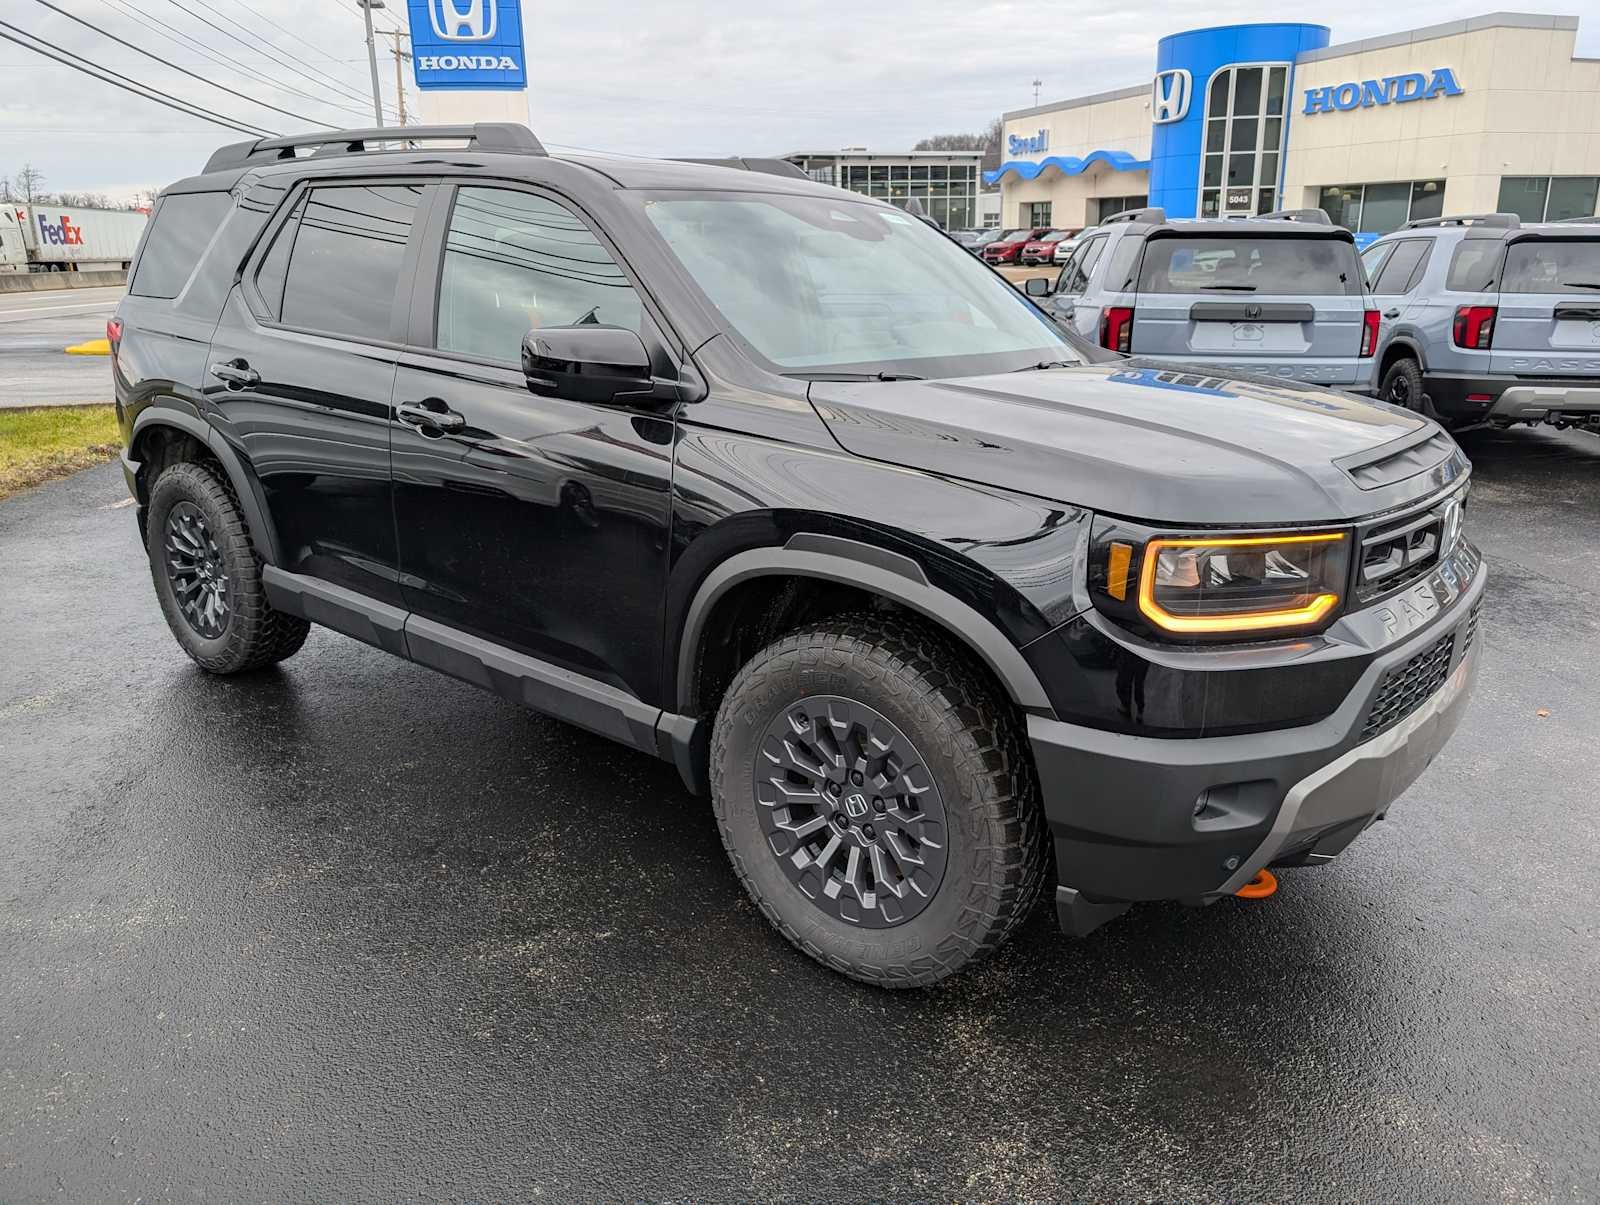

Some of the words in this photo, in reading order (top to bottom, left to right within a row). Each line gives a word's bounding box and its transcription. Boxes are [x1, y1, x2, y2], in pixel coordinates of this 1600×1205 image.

[418, 56, 519, 70] HONDA
[1303, 67, 1464, 115] HONDA
[1229, 195, 1249, 204] 5043
[38, 214, 84, 246] FedEx
[1509, 359, 1600, 371] PASS
